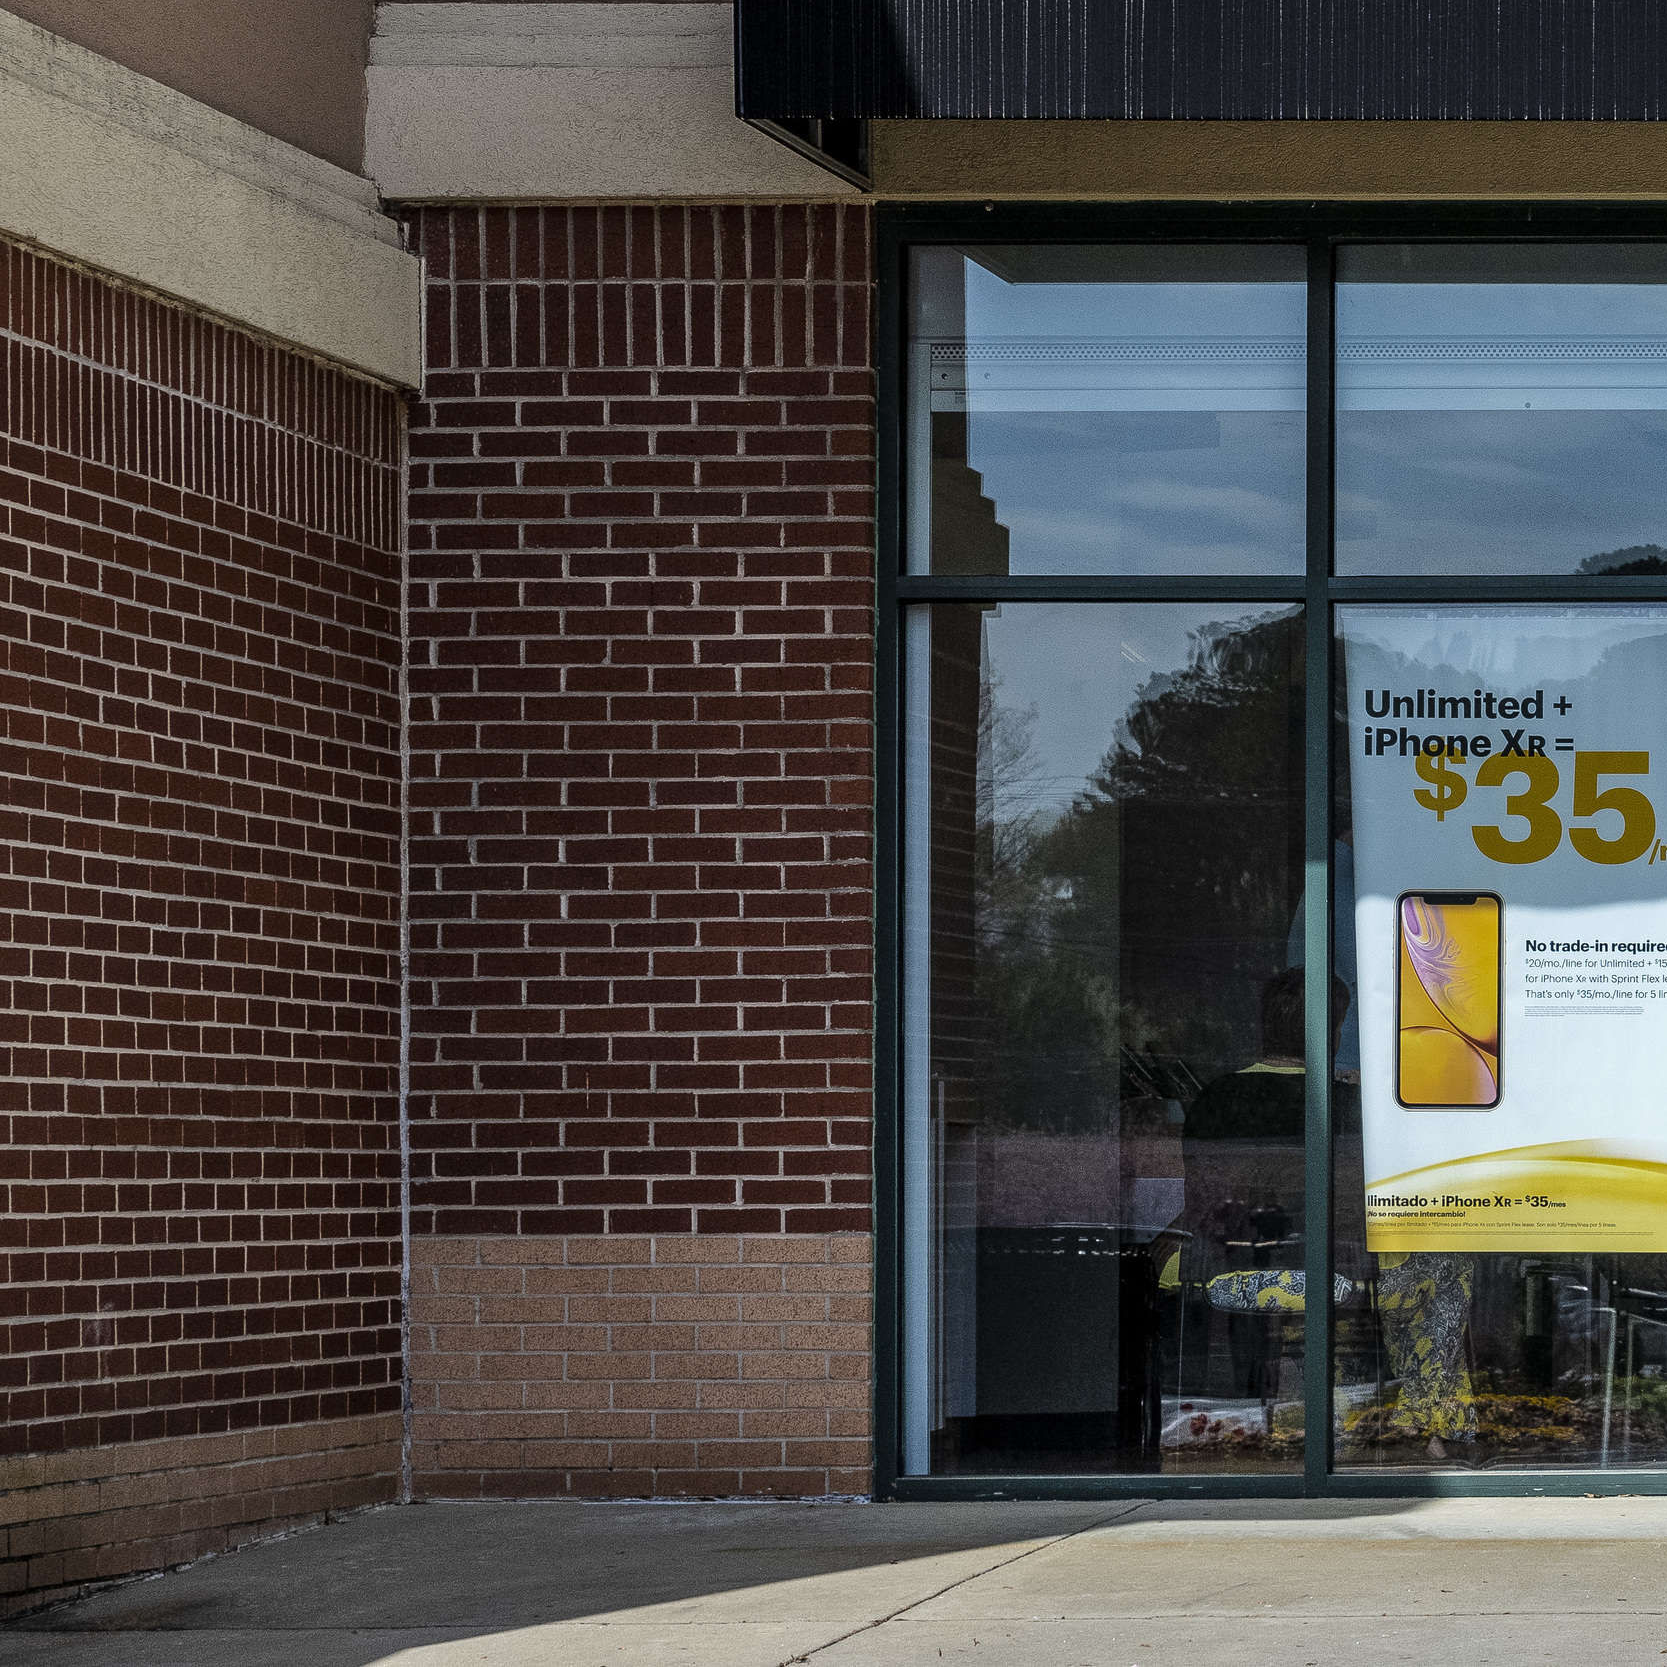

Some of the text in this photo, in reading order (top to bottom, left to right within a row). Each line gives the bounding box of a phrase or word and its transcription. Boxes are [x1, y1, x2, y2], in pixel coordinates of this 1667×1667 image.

[1364, 689, 1573, 720] Unlimited +
[1364, 726, 1492, 758] iPhone
[1555, 738, 1574, 751] =
[1525, 940, 1547, 952] No
[1550, 939, 1608, 952] trade-in
[1584, 958, 1598, 968] for
[1600, 958, 1645, 968] Unlimited
[1525, 974, 1538, 983] for
[1540, 974, 1573, 983] iPhone
[1589, 974, 1609, 983] with
[1611, 974, 1639, 985] Sprint
[1641, 974, 1660, 983] Flex
[1554, 989, 1574, 1000] only
[1635, 989, 1648, 999] for
[1650, 989, 1656, 999] 5
[1431, 1197, 1439, 1205] +
[1441, 1195, 1490, 1207] iPhone
